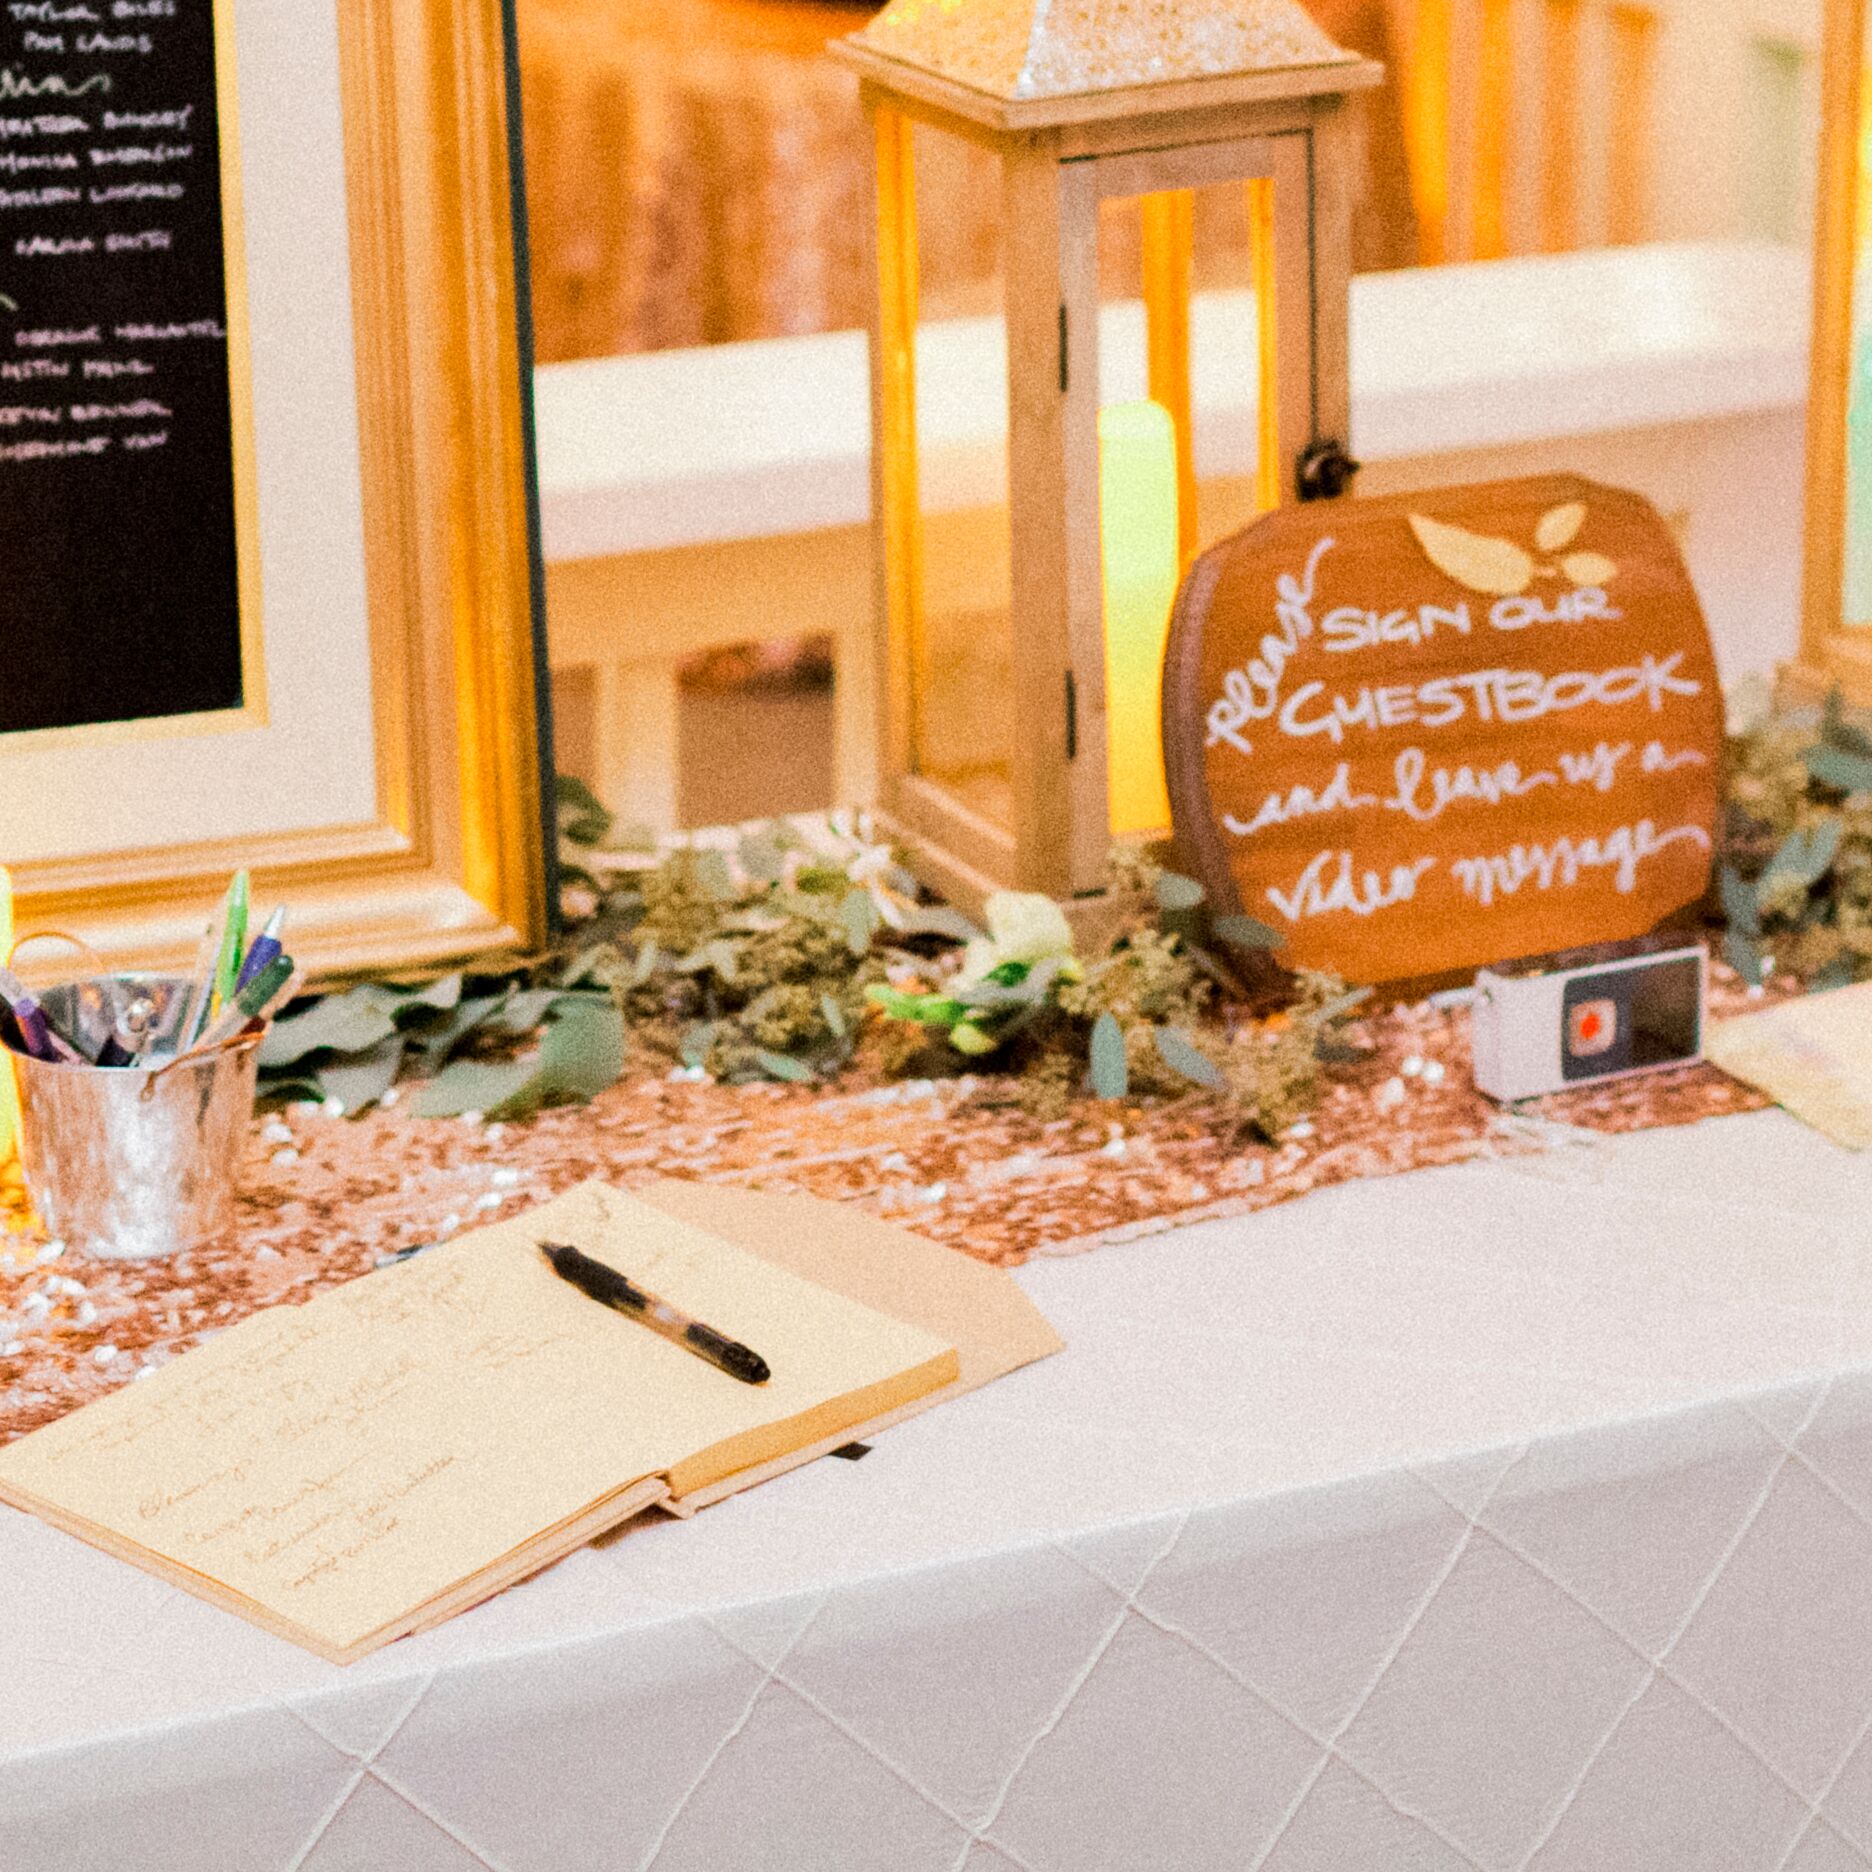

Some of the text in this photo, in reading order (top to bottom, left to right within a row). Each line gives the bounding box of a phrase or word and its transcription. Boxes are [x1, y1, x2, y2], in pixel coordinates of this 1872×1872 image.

[1320, 585, 1622, 653] SIGN OUR
[1277, 650, 1701, 743] GUESTBOOK
[1223, 738, 1706, 837] and leave us a
[1450, 818, 1711, 906] message
